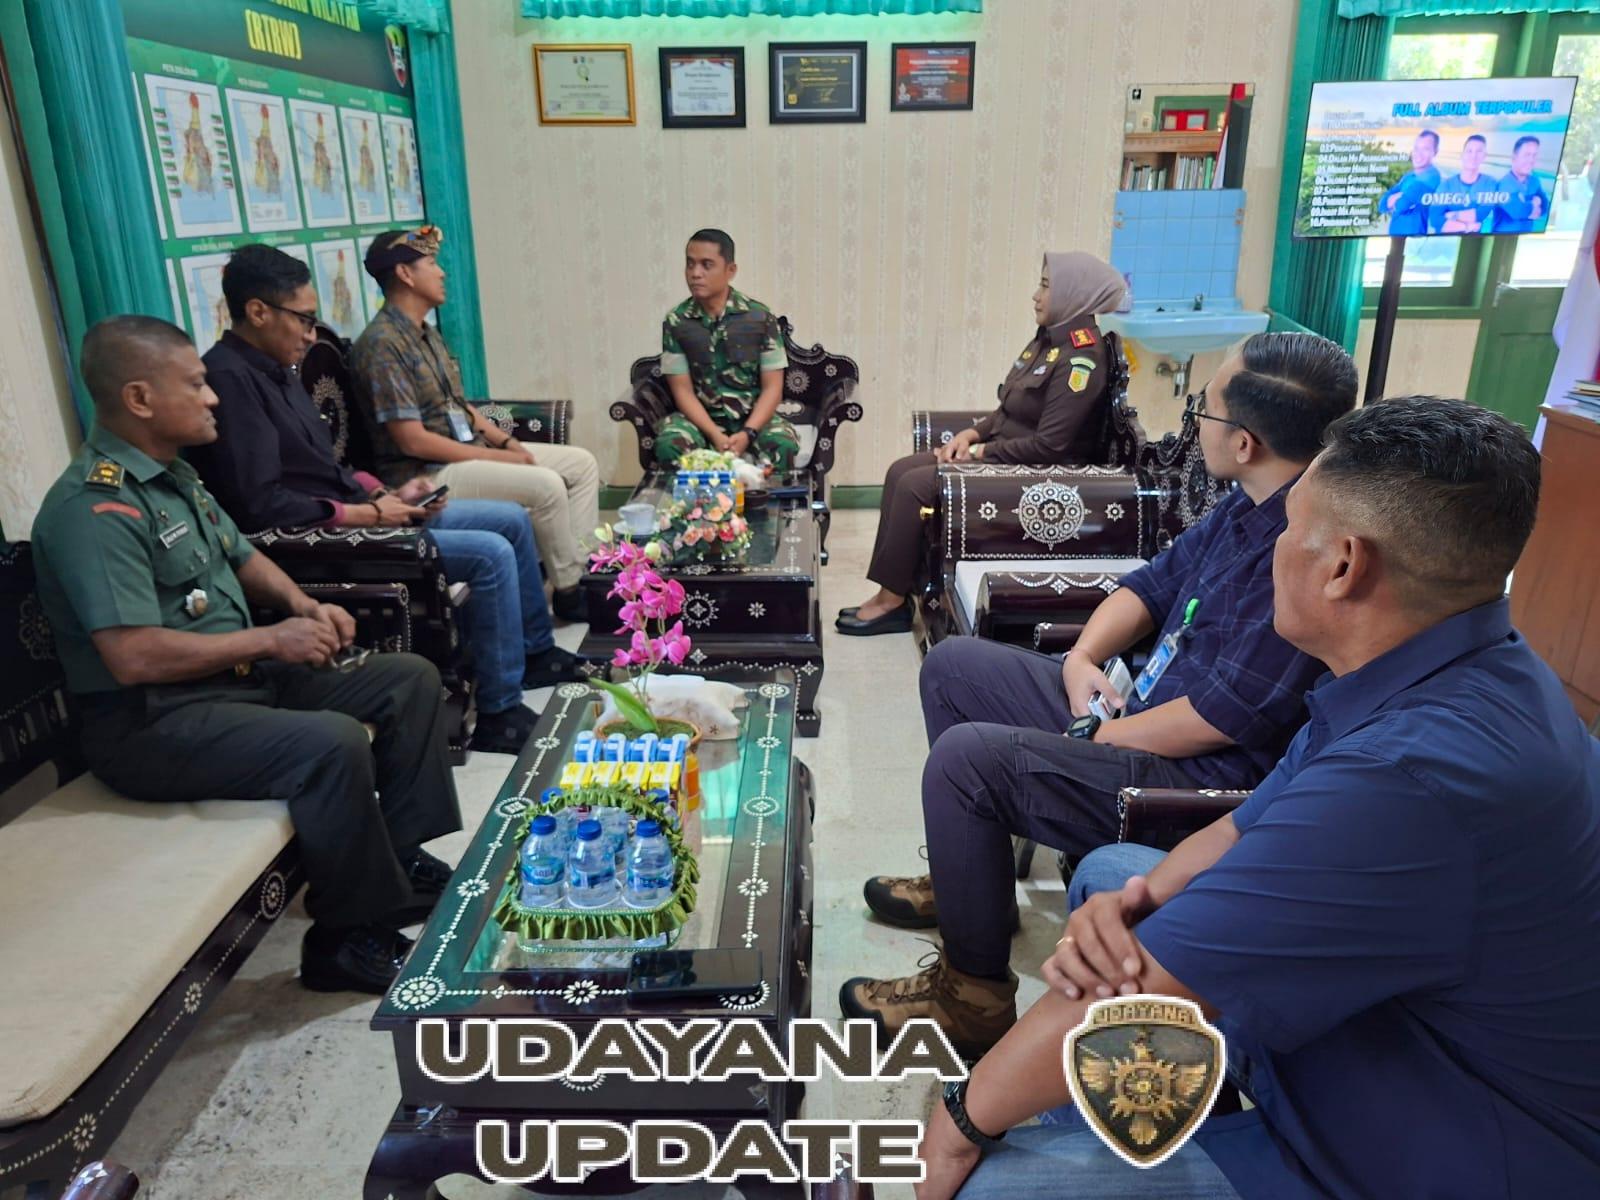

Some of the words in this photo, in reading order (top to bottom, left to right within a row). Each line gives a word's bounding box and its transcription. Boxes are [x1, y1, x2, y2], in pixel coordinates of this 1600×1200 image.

[1392, 104, 1422, 118] FULL
[1425, 102, 1471, 117] ALBUM
[1475, 100, 1553, 115] TERPOPULER
[1422, 194, 1471, 207] OMEGA
[1477, 192, 1511, 205] TRIO
